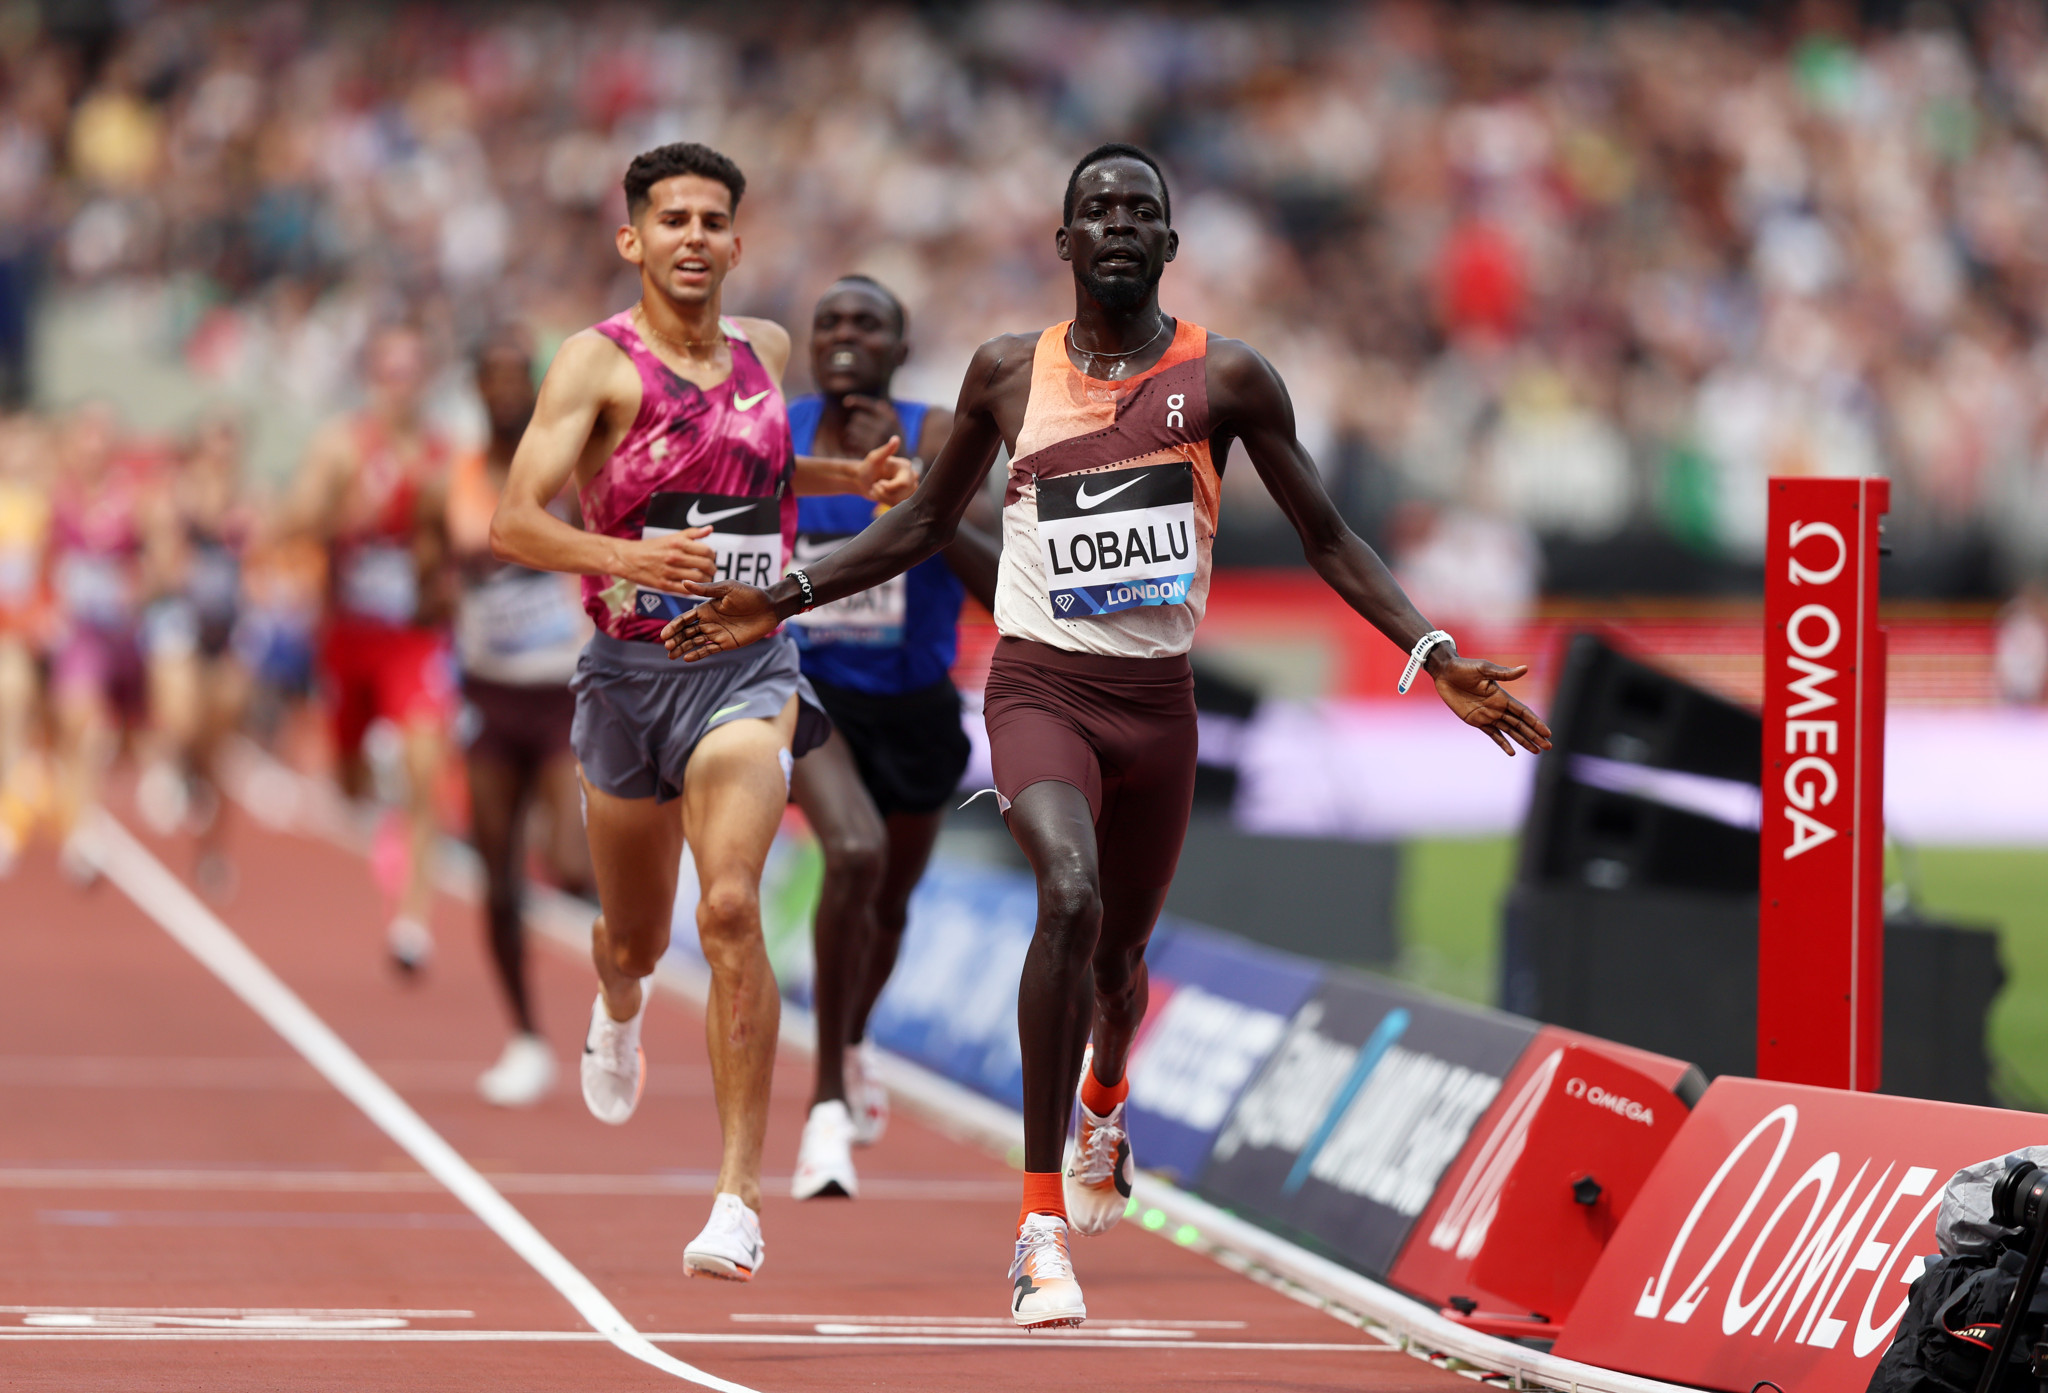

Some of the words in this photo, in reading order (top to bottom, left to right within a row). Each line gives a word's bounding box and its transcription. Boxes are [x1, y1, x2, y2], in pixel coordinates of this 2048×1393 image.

[712, 552, 772, 587] HER
[1048, 521, 1189, 575] LOBALU
[1106, 581, 1186, 606] LONDON
[1784, 604, 1841, 860] OMEGA
[1587, 1086, 1654, 1127] OMEGA
[1722, 1151, 1948, 1358] OMEG
